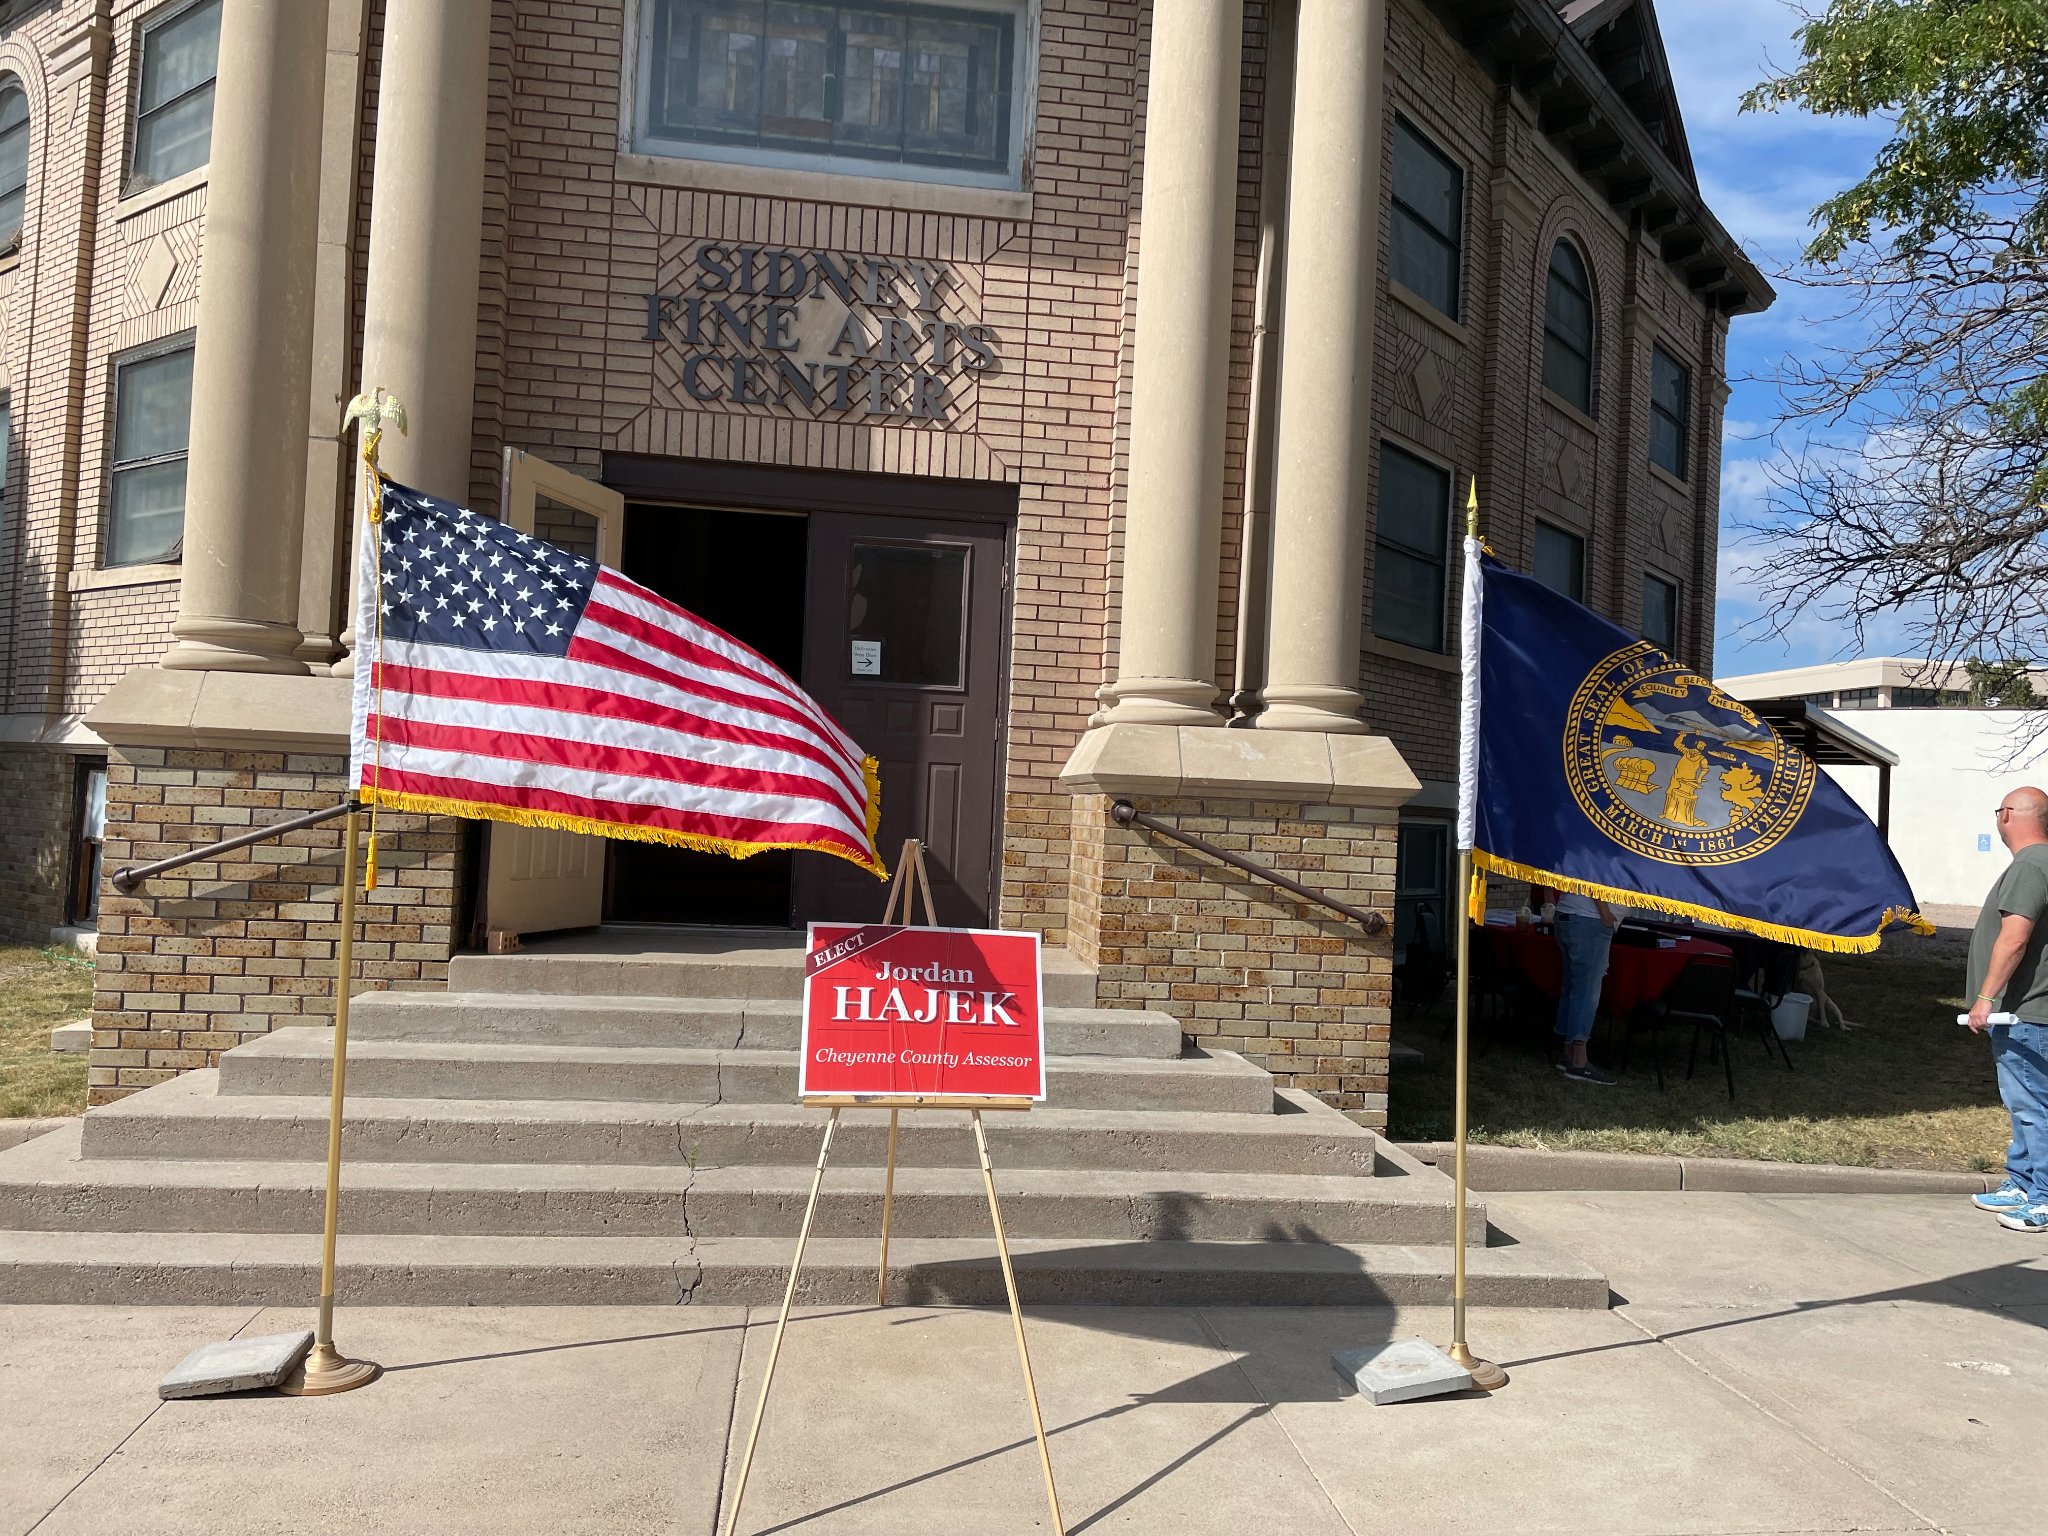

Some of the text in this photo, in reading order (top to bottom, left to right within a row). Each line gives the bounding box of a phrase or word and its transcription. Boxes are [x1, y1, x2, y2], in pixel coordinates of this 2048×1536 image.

[696, 244, 948, 312] SIDNEY
[641, 294, 994, 371] FINE ARTS
[683, 354, 948, 420] CENTER
[1583, 681, 1616, 721] SEAL
[1641, 684, 1687, 697] EQUALITY
[1730, 701, 1752, 718] LAW
[1578, 733, 1600, 793] GREAT
[1749, 744, 1800, 835] NEBRASKA
[1604, 803, 1663, 845] MARCH
[1699, 836, 1736, 852] 1867
[813, 932, 866, 968] ELECT
[875, 961, 975, 984] Jordan
[832, 985, 1019, 1027] HAJEK
[815, 1047, 1033, 1068] Cheyenne County Assessor
